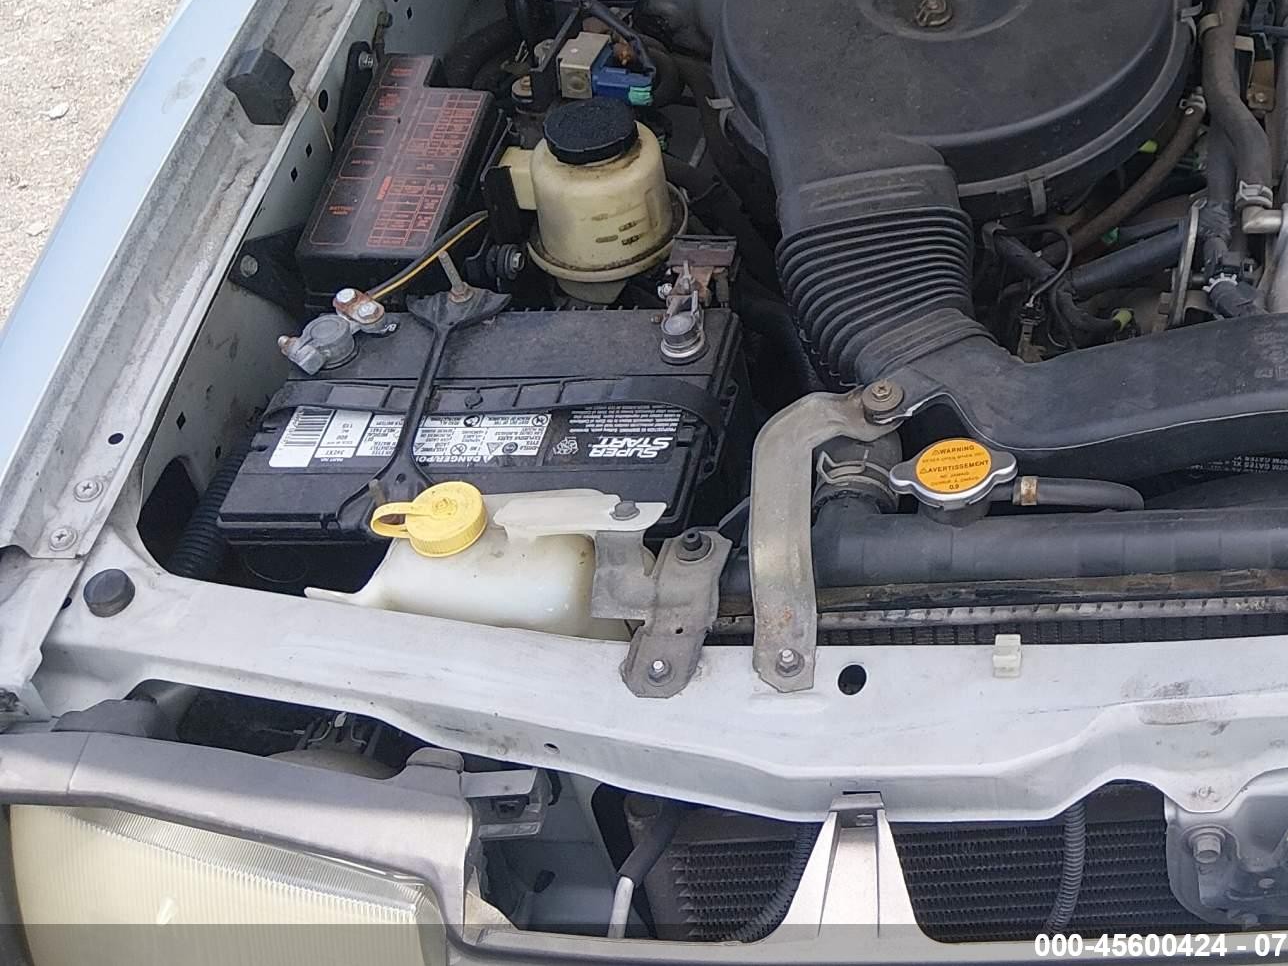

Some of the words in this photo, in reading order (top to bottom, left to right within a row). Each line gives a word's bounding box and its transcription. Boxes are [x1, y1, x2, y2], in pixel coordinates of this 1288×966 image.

[591, 437, 673, 448] START
[589, 447, 658, 458] SUPER
[940, 445, 975, 455] WARNING
[928, 459, 989, 473] AVERTISSEMENT
[1244, 462, 1271, 470] GATES
